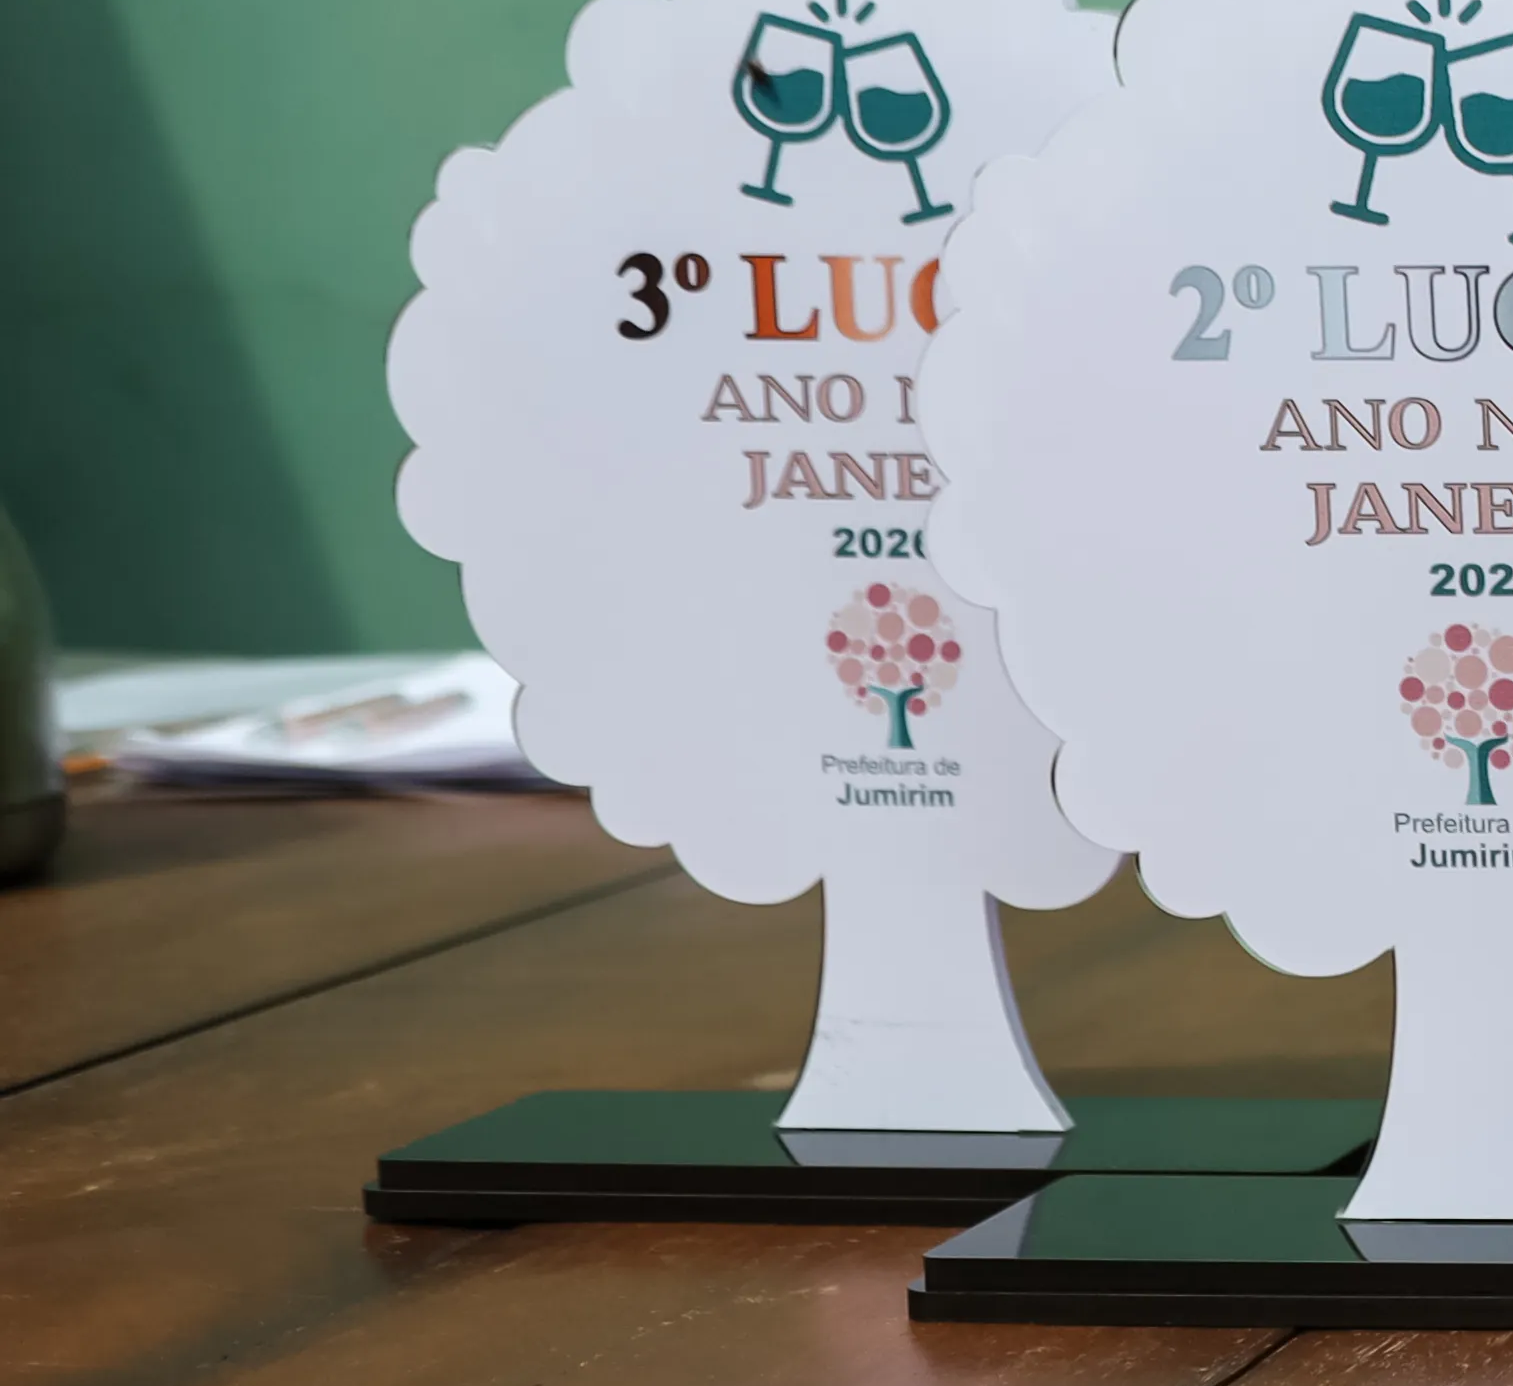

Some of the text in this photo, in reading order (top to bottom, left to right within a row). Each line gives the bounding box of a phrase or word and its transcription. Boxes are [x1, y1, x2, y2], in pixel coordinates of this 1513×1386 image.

[701, 374, 864, 422] ANO
[1260, 397, 1441, 451] ANO
[821, 754, 961, 776] Prefeitura de
[836, 783, 954, 807] Jumirim
[1394, 812, 1509, 833] Prefeitura
